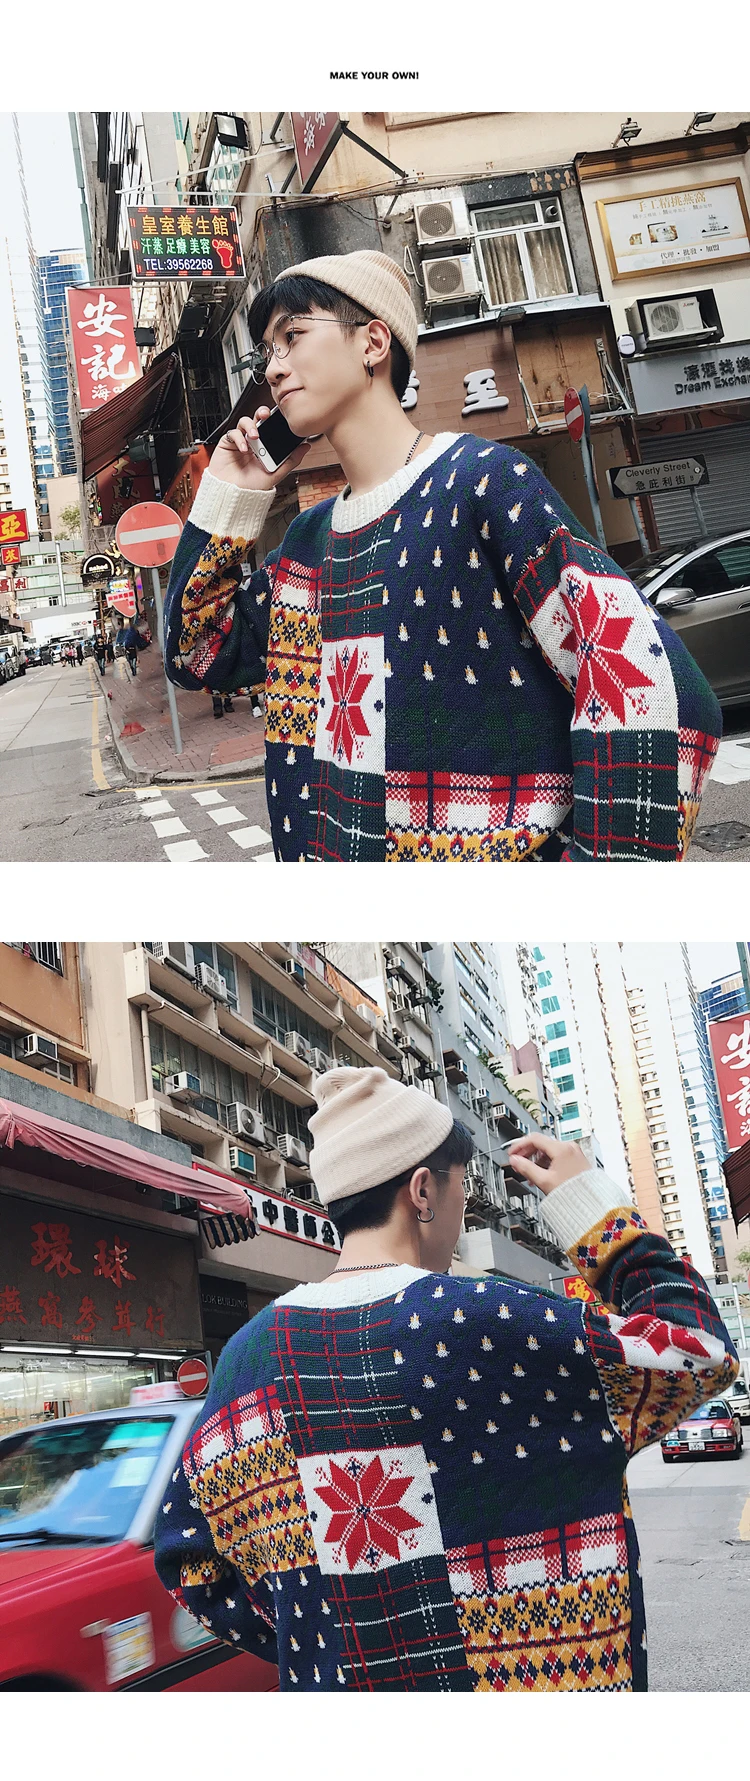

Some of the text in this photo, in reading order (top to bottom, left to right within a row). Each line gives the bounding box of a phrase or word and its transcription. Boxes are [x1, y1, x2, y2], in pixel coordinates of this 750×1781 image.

[142, 215, 229, 237] 皇室養生館
[140, 237, 164, 255] 汗蒸
[190, 237, 211, 255] 美容
[143, 258, 214, 271] TEL:39562268
[77, 293, 136, 381] 安記
[674, 380, 711, 395] Dream
[625, 461, 691, 478] Cleverly Street
[0, 514, 26, 543] 亞
[30, 1222, 137, 1289] 環球
